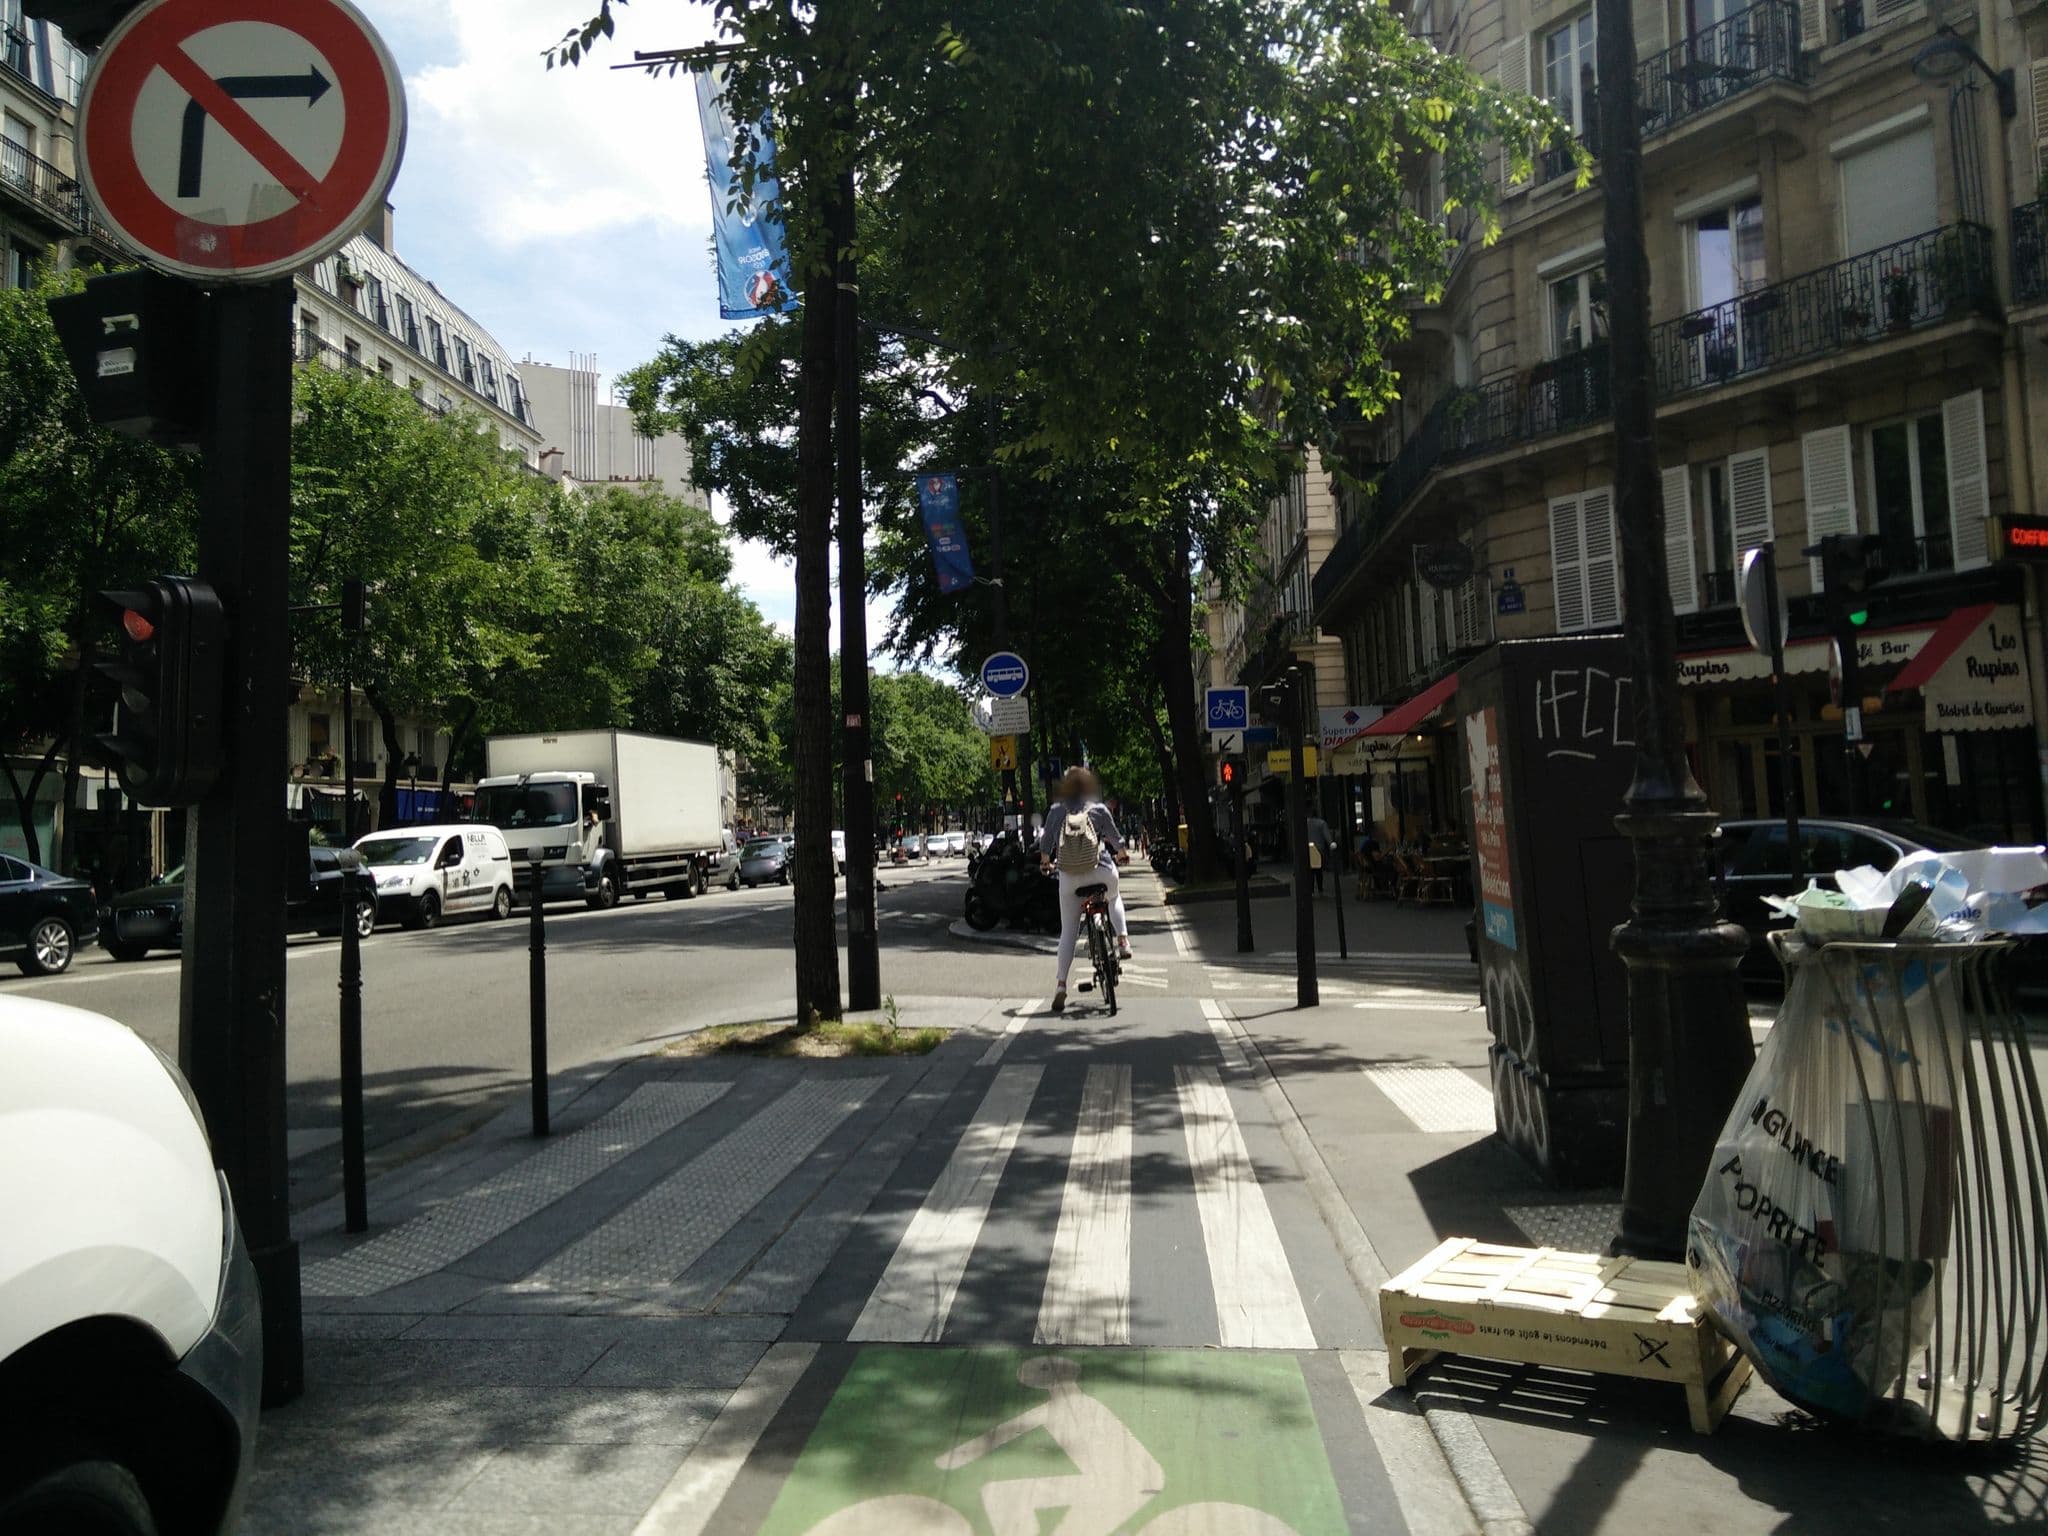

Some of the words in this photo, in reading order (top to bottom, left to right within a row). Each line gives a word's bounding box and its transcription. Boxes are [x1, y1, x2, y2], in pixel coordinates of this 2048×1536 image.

[1988, 623, 2017, 651] Les
[1881, 641, 1910, 655] Bar
[1676, 660, 1730, 682] Rupins
[1966, 656, 2019, 683] Rupins
[1972, 700, 1984, 716] de
[1985, 702, 2025, 718] Quartier
[1479, 1325, 1500, 1336] frais
[1504, 1328, 1515, 1338] du
[1543, 1333, 1552, 1342] le
[1556, 1334, 1607, 1350] Défendons
